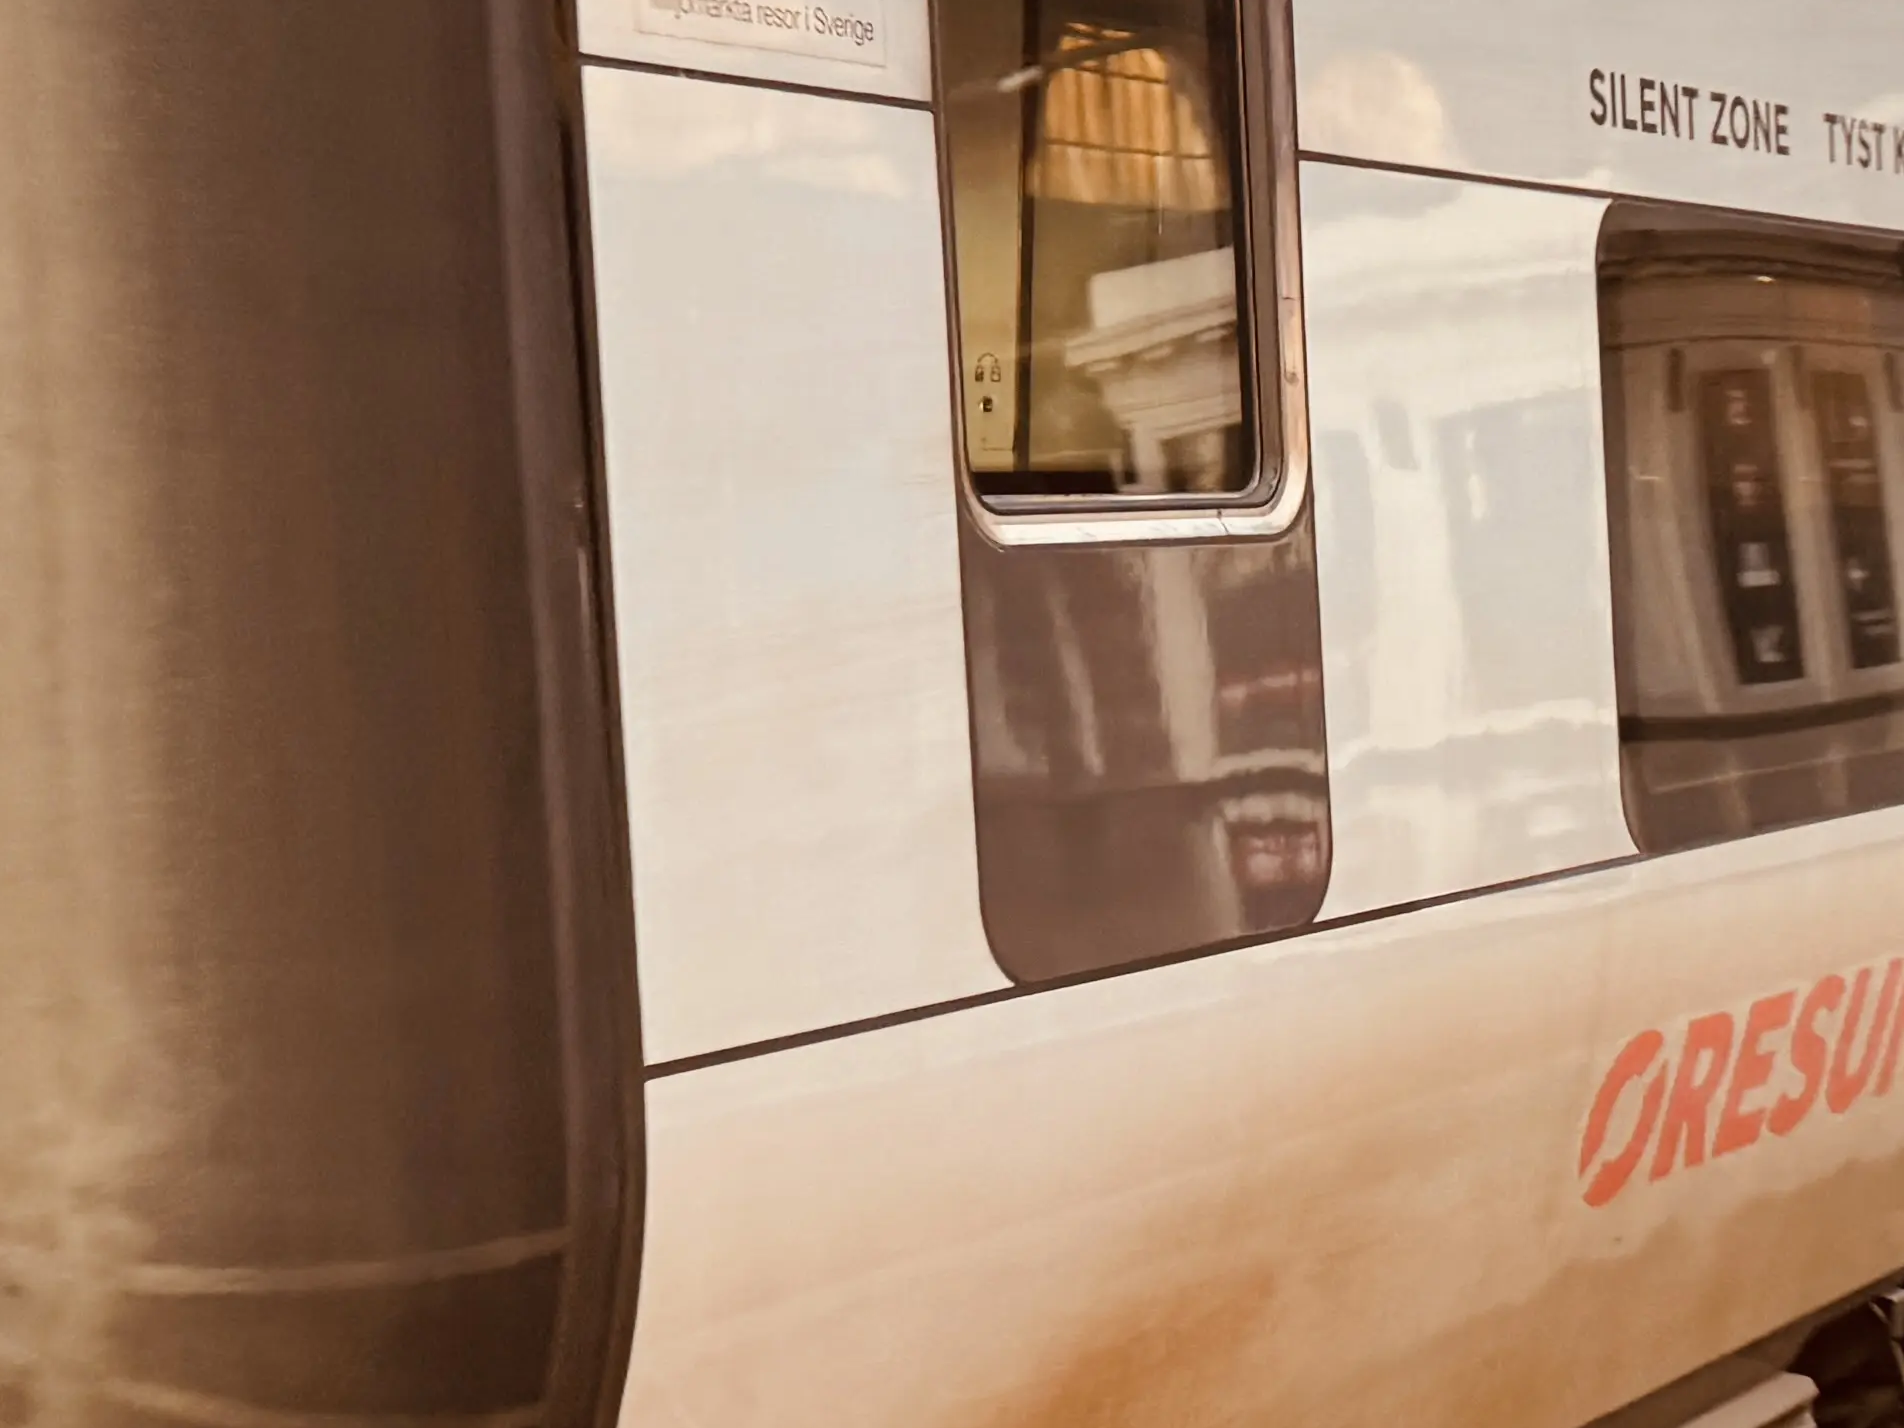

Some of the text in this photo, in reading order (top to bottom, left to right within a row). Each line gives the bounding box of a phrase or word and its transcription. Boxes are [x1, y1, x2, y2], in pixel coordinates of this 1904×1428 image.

[756, 3, 802, 31] resor
[804, 6, 811, 32] i
[814, 6, 875, 47] Sverige
[1588, 67, 1700, 142] SILENT
[1709, 91, 1791, 156] ZONE
[1822, 112, 1886, 172] TYST
